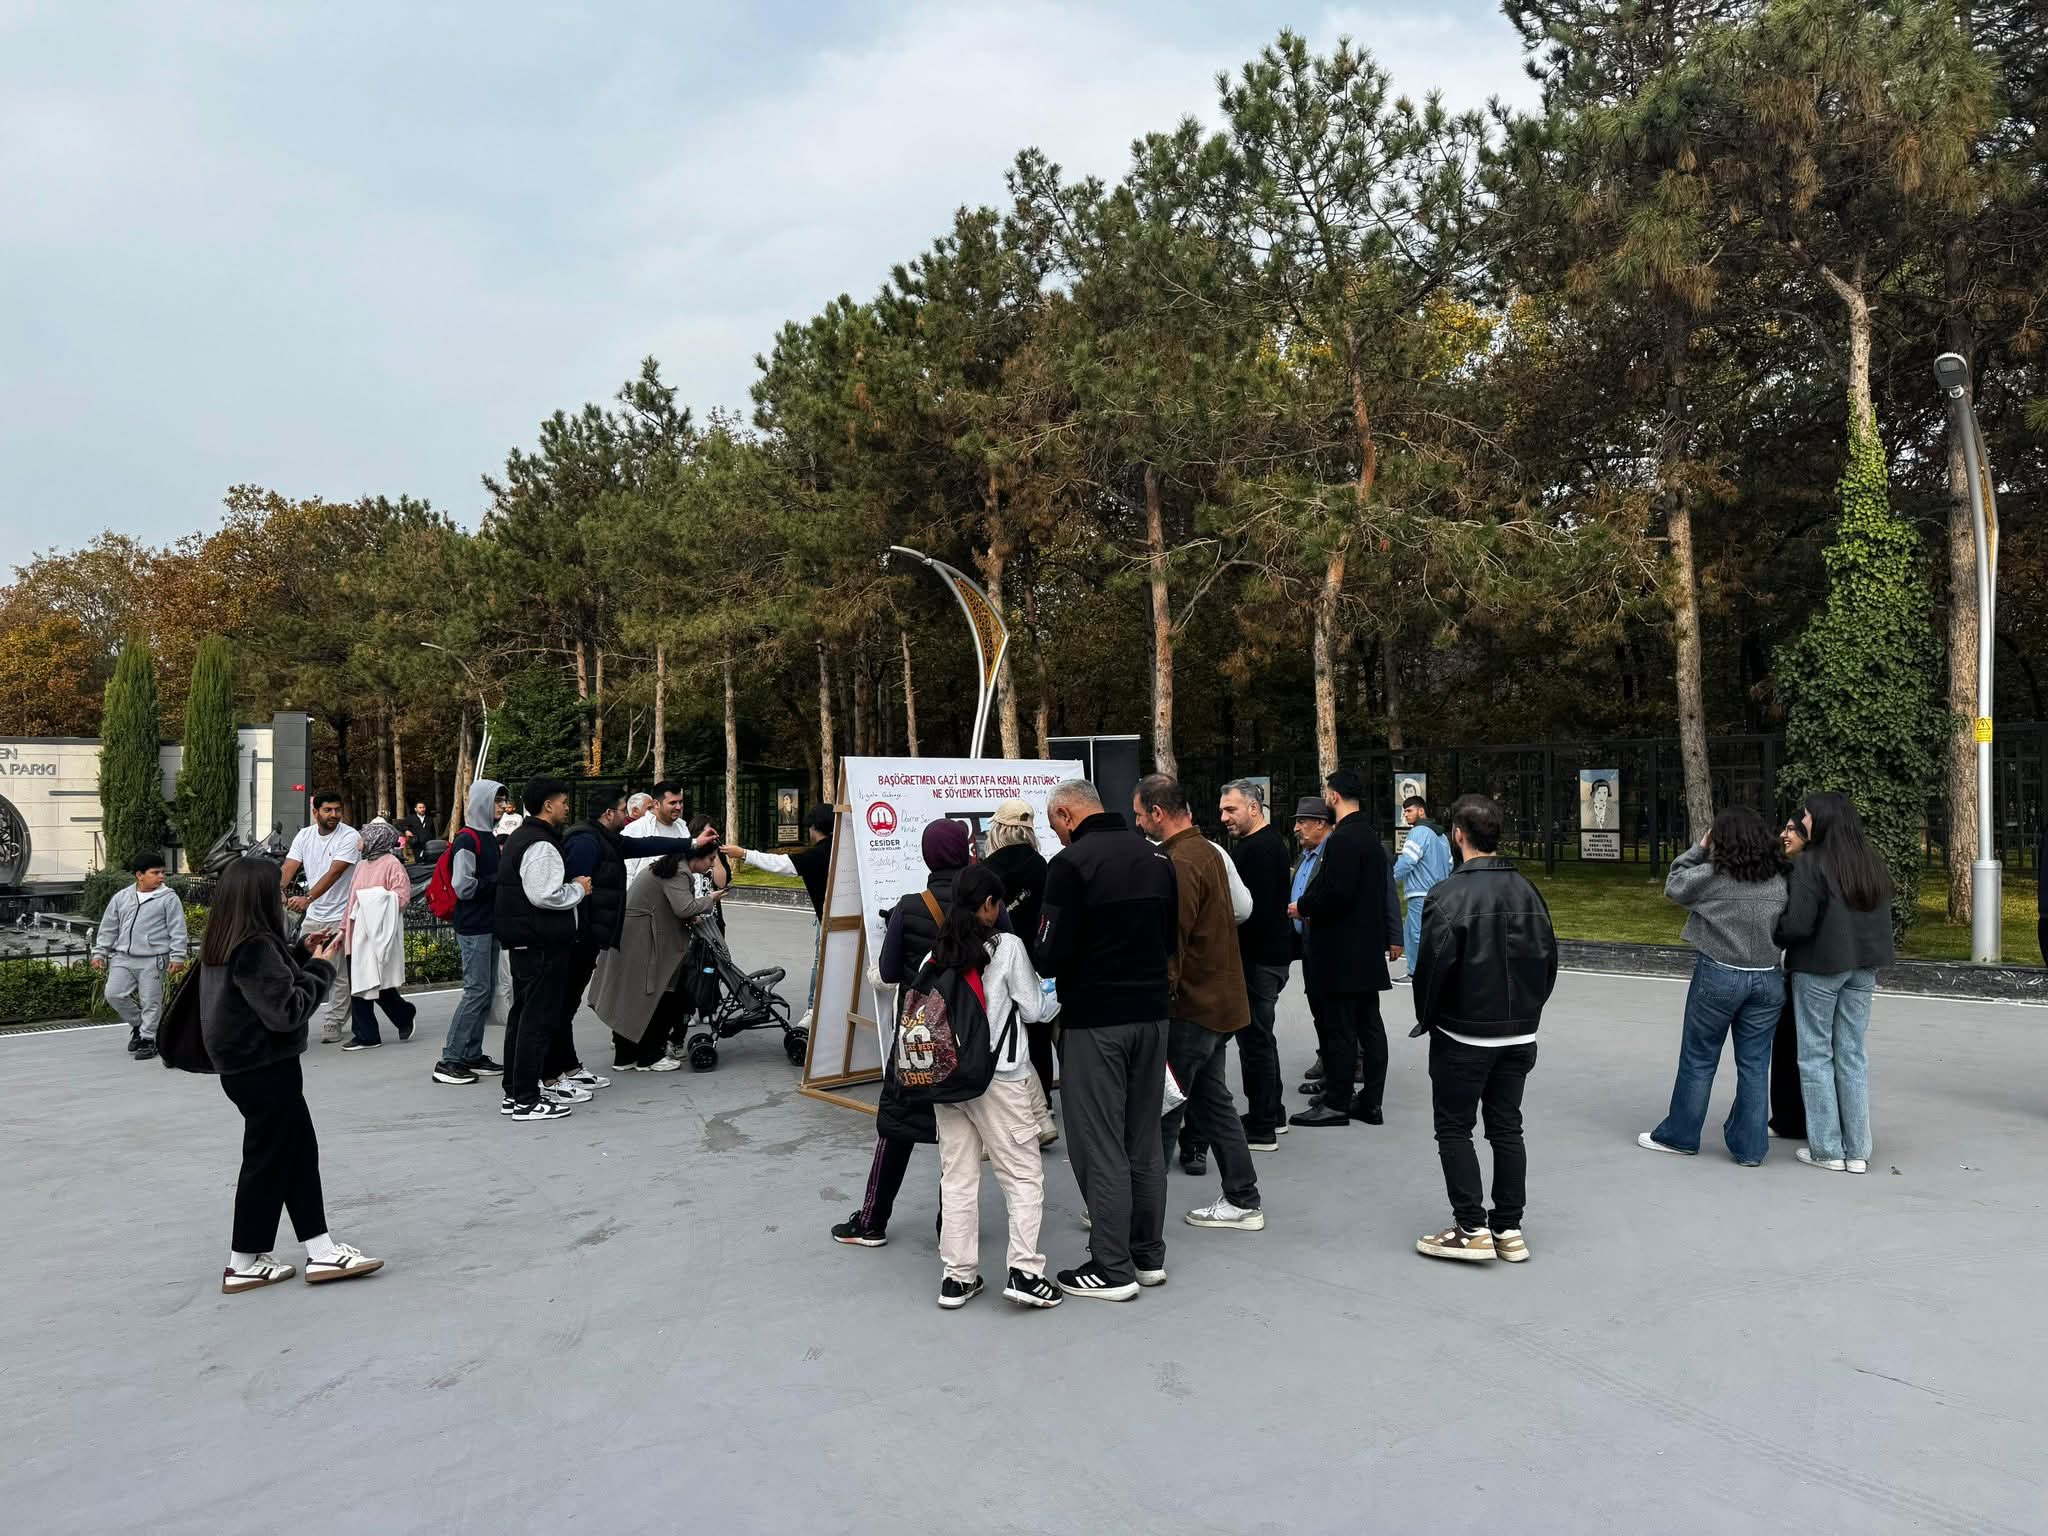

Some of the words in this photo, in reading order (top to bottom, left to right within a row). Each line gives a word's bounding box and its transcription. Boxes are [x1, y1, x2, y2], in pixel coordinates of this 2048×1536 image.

[10, 763, 57, 775] PARKI
[878, 773, 936, 787] BAŞÖĞRETMEN
[938, 773, 958, 786] GAZİ
[960, 775, 995, 786] MUSTAFA
[997, 775, 1021, 786] KEMAL
[932, 788, 943, 799] NE
[945, 786, 982, 799] SÖYLEMEK
[984, 786, 1021, 799] İSTERSİN?
[903, 1072, 934, 1086] 1905
